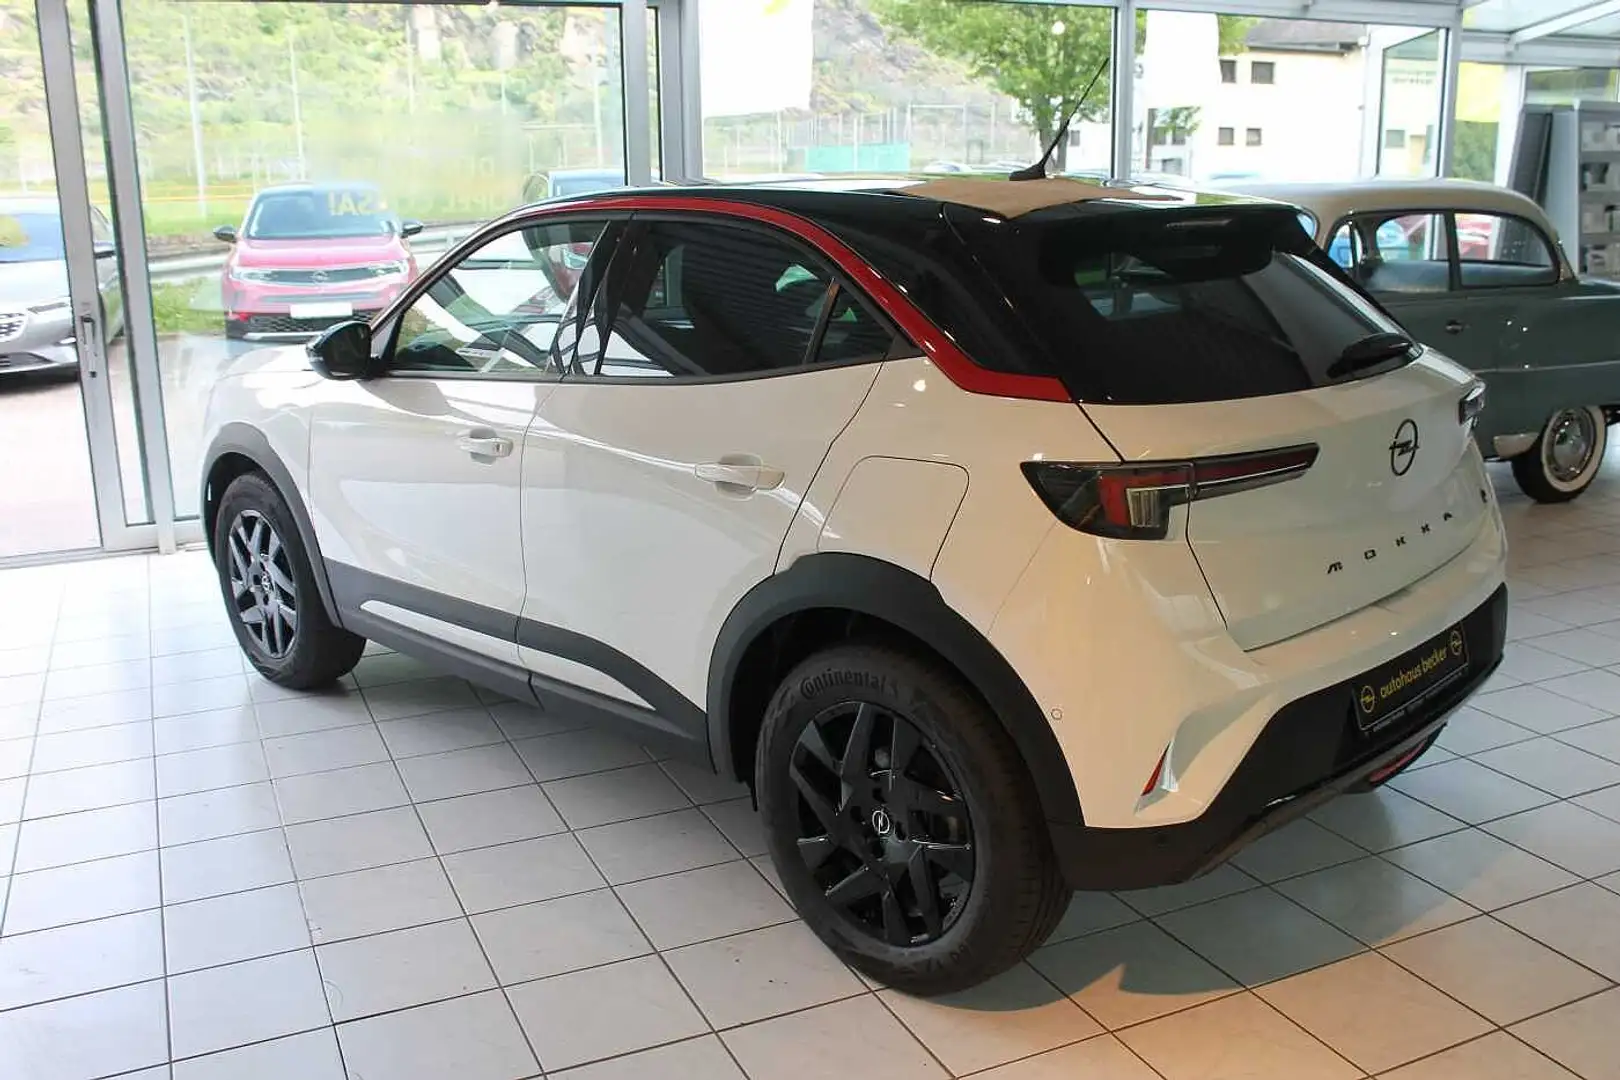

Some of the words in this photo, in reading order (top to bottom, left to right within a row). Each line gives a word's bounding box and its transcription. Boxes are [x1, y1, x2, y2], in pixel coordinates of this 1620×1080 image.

[1327, 511, 1453, 574] MOKKA
[800, 668, 887, 700] Continental
[1380, 664, 1423, 698] autohaus
[1422, 647, 1449, 674] becker
